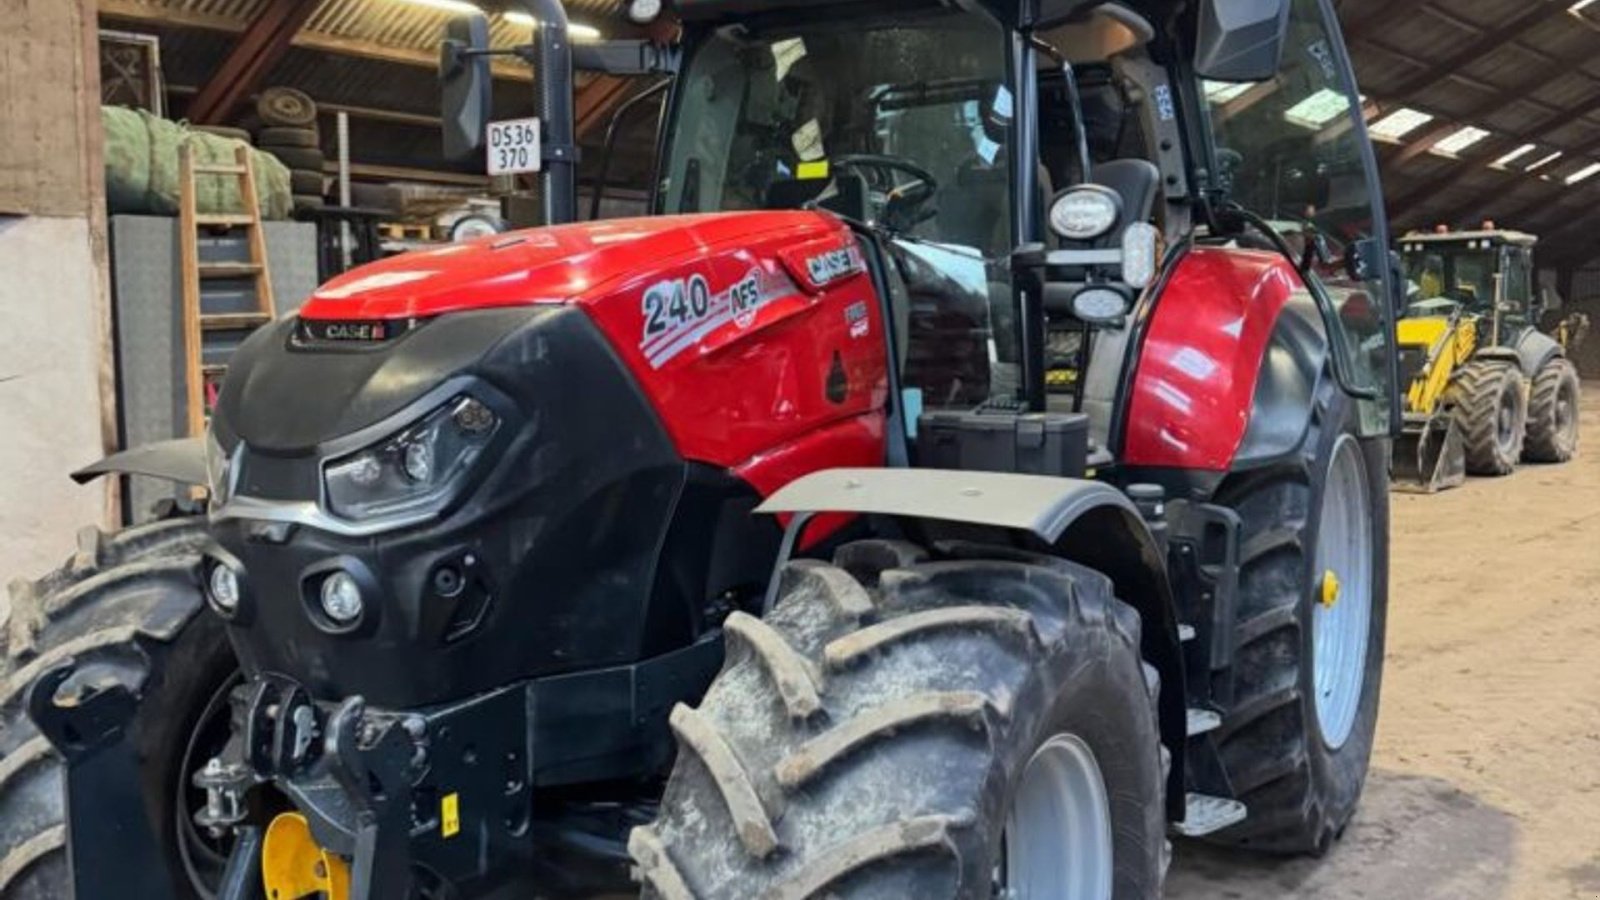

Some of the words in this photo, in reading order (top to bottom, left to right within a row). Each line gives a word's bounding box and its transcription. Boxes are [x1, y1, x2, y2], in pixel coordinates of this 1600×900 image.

[491, 125, 534, 147] DS36
[499, 146, 528, 169] 370
[645, 276, 708, 335] 240
[731, 278, 759, 315] AFS
[326, 324, 370, 339] CASE
